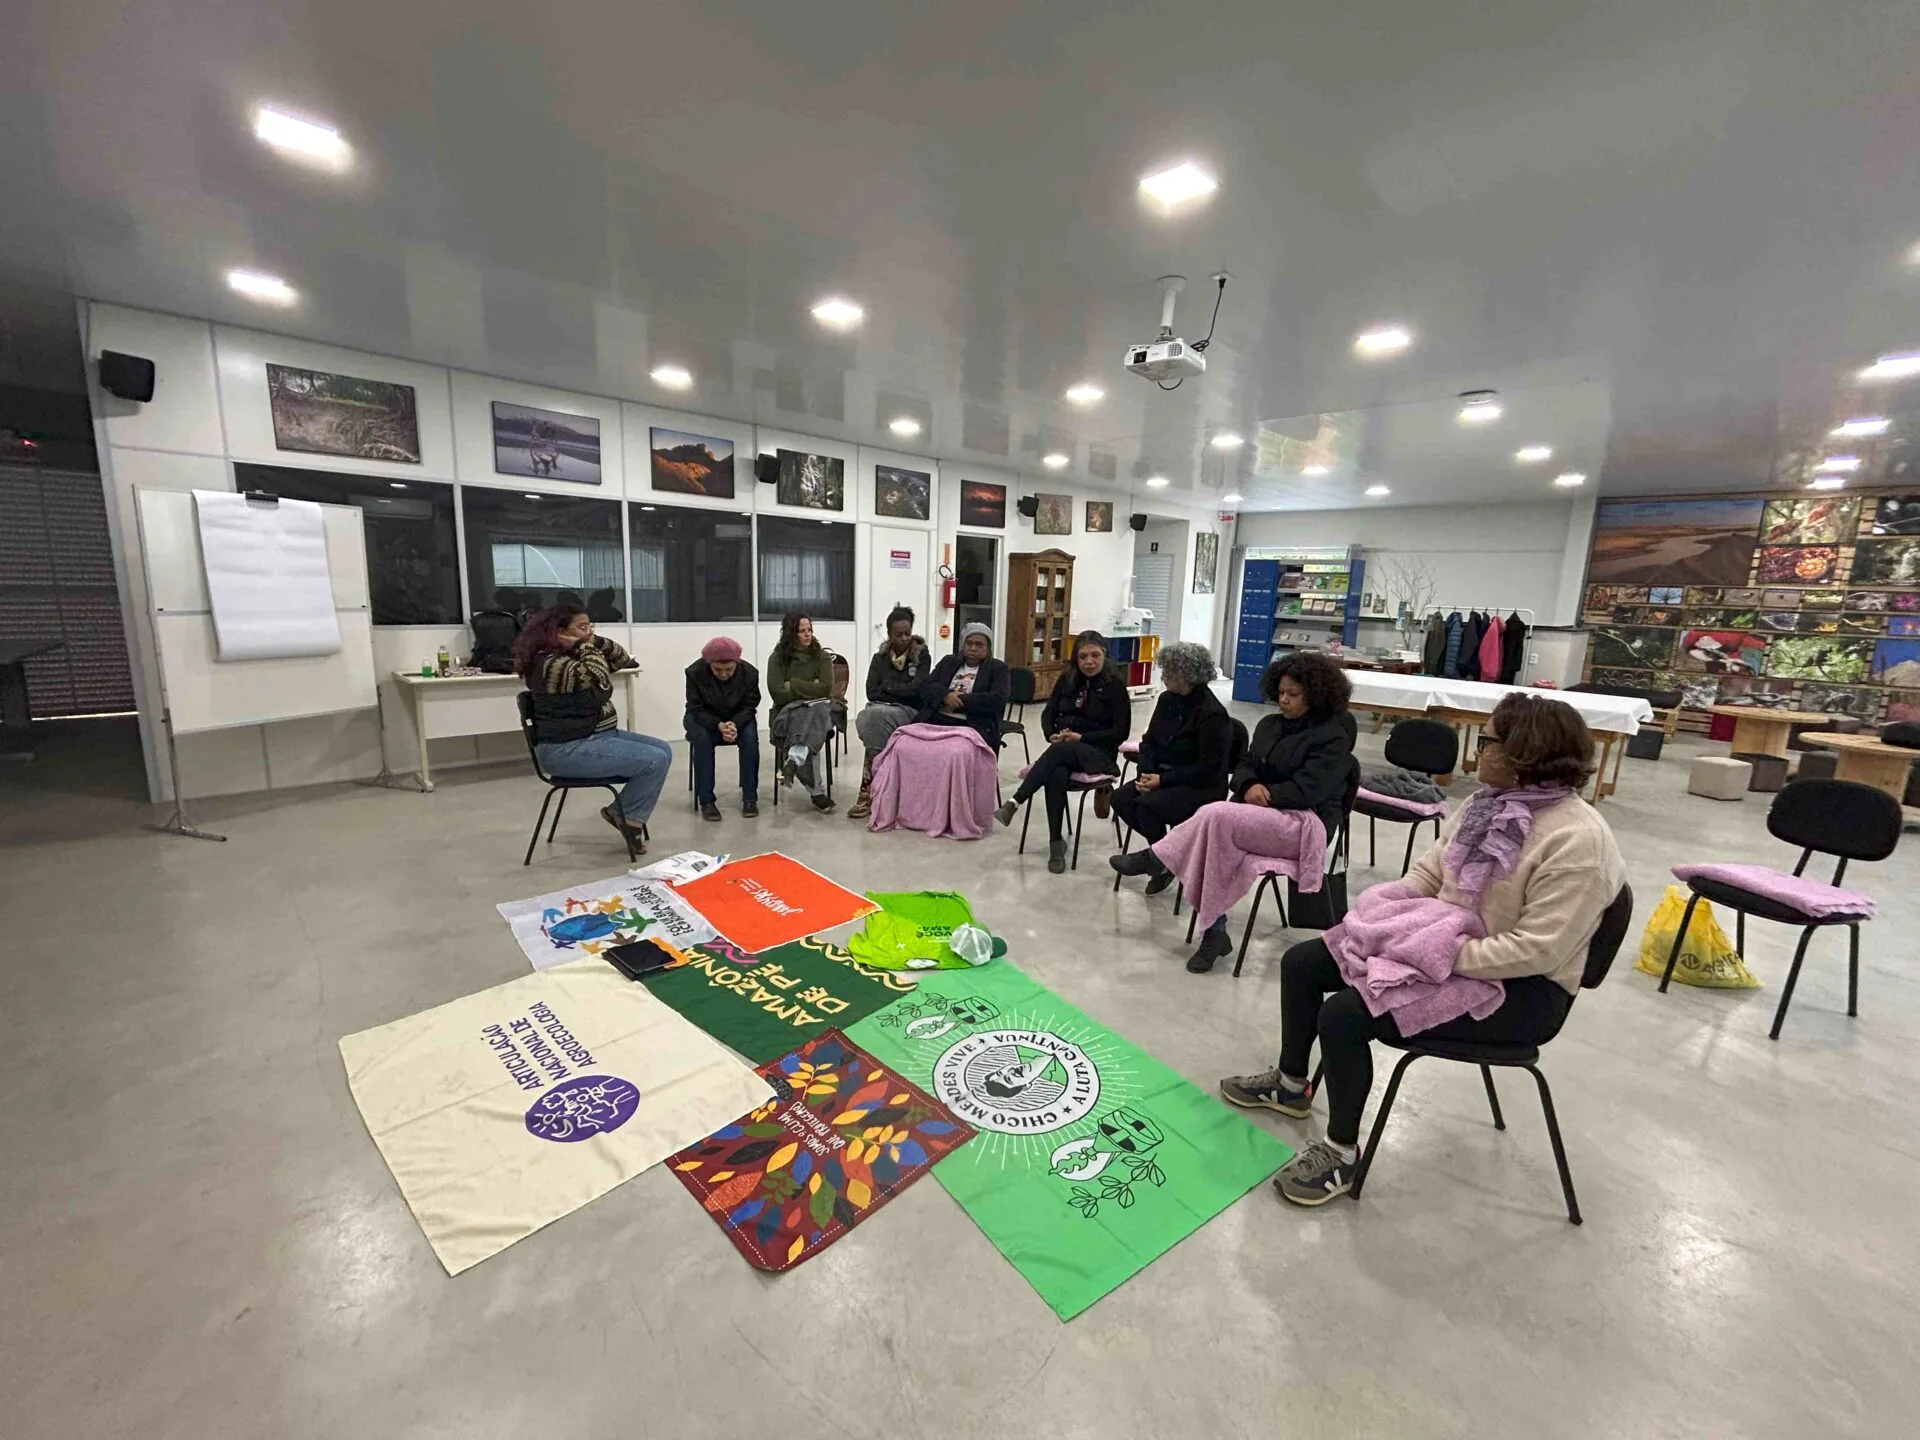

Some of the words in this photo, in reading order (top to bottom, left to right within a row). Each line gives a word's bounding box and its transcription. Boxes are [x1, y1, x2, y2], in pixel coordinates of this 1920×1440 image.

[915, 931, 953, 940] VOCÊ
[682, 947, 825, 1027] AMAZÔNIA
[795, 986, 851, 1014] DE
[509, 1017, 532, 1034] DE
[528, 1001, 597, 1068] AGROECOLOGIA
[480, 1024, 544, 1090] ARTICULAÇÃO
[520, 1029, 571, 1081] NACIONAL
[1075, 1062, 1091, 1094] LUTA
[942, 1071, 988, 1120] MENDES
[1072, 1095, 1087, 1105] A
[992, 1112, 1059, 1128] CHICO
[804, 1133, 830, 1156] SOMOS
[826, 1134, 846, 1150] QUE
